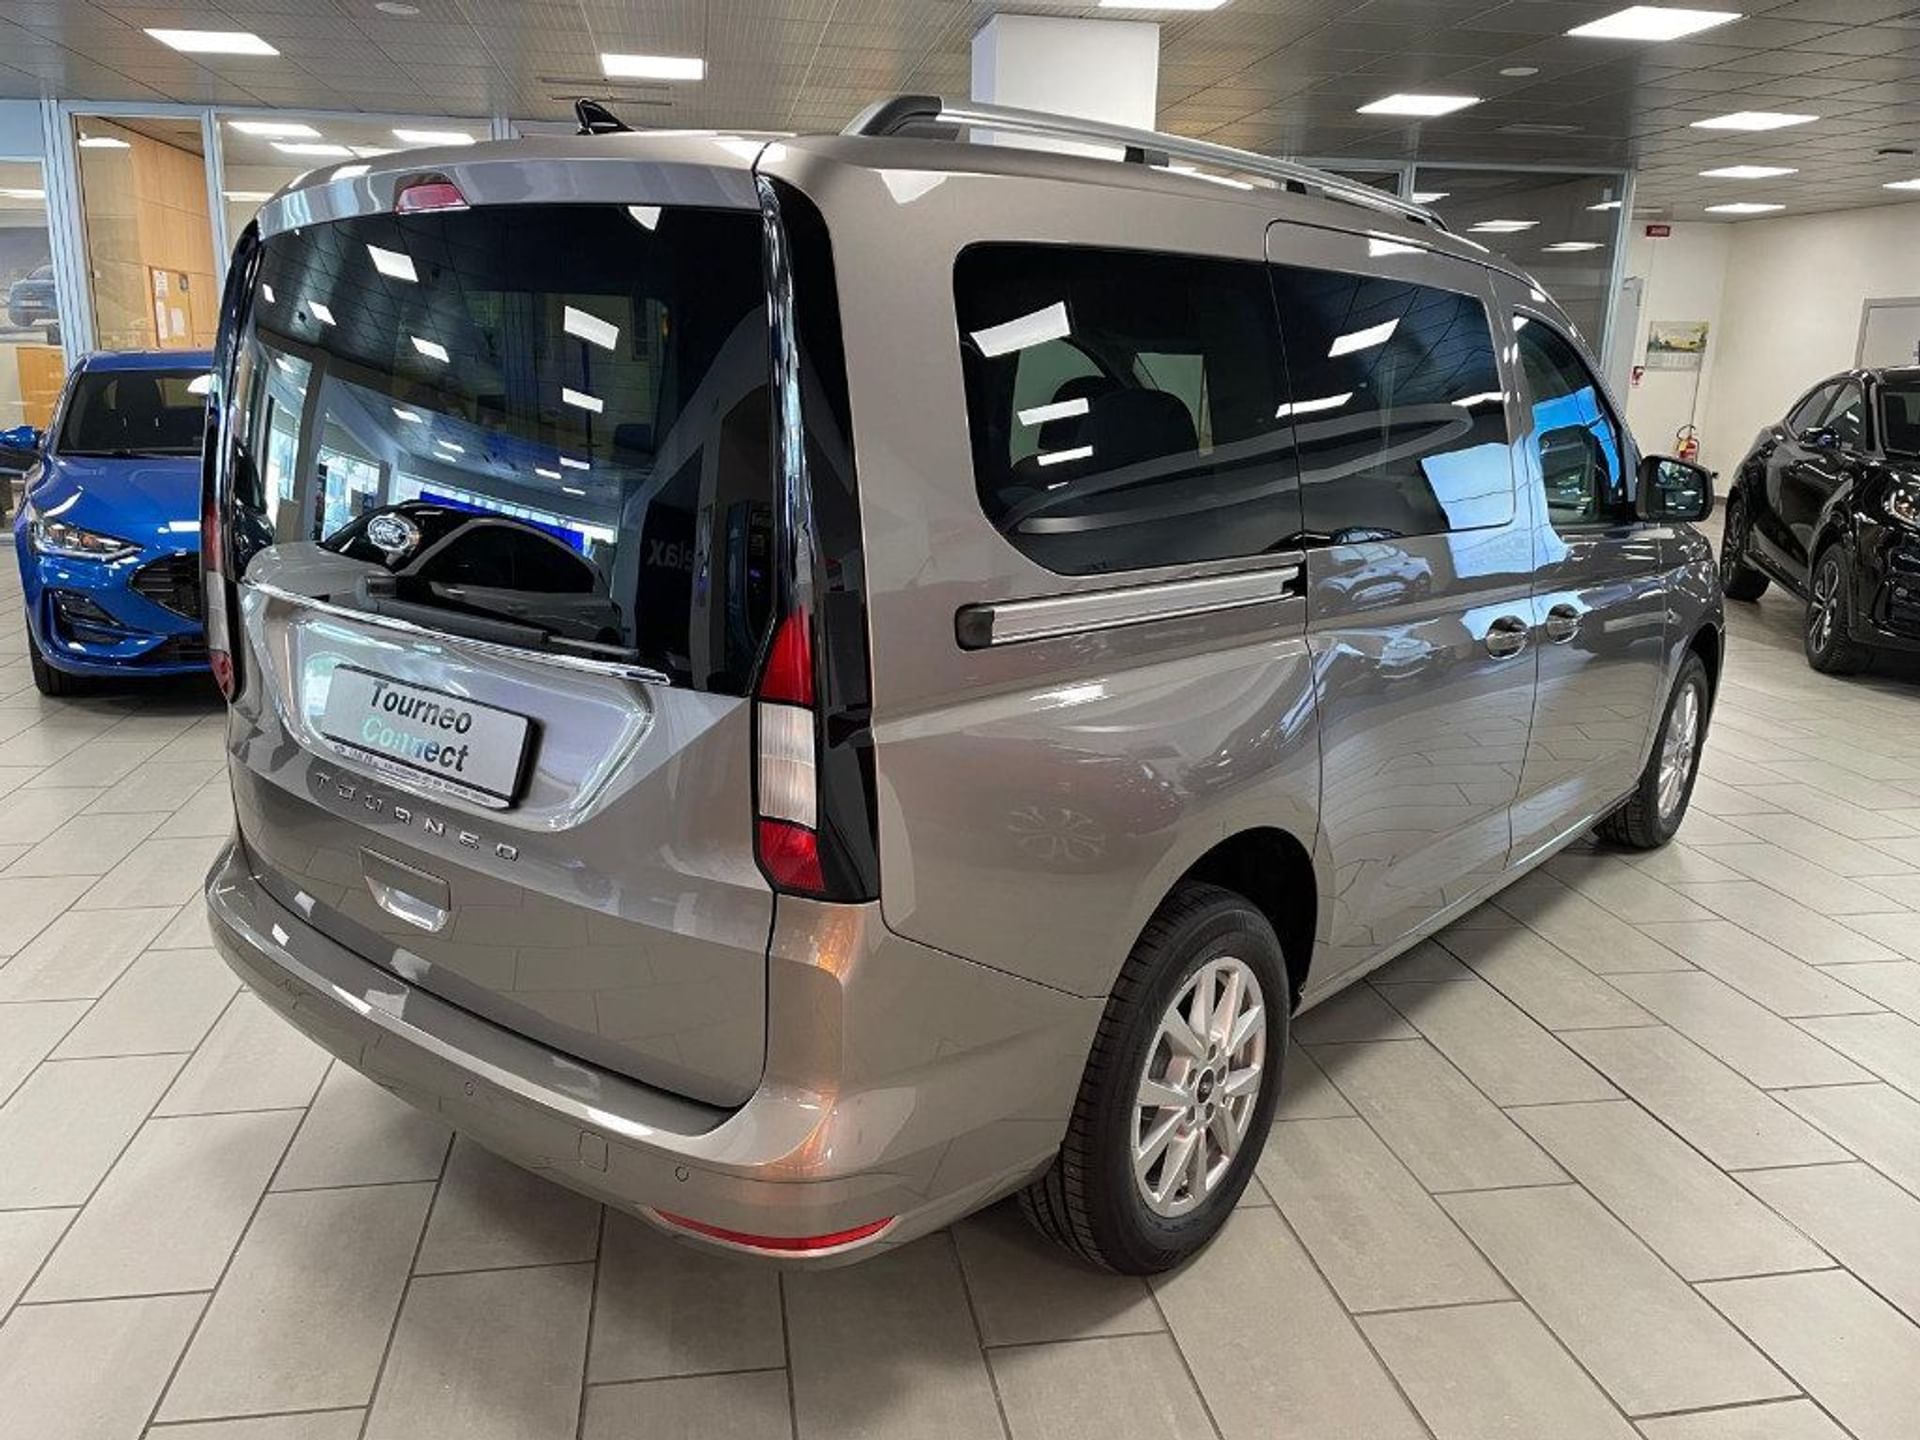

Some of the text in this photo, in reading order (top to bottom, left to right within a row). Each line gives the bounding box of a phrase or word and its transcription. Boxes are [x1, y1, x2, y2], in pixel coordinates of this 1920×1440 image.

[370, 681, 472, 734] Tourneo
[361, 714, 470, 772] Connect
[315, 772, 519, 862] TOURNEO
